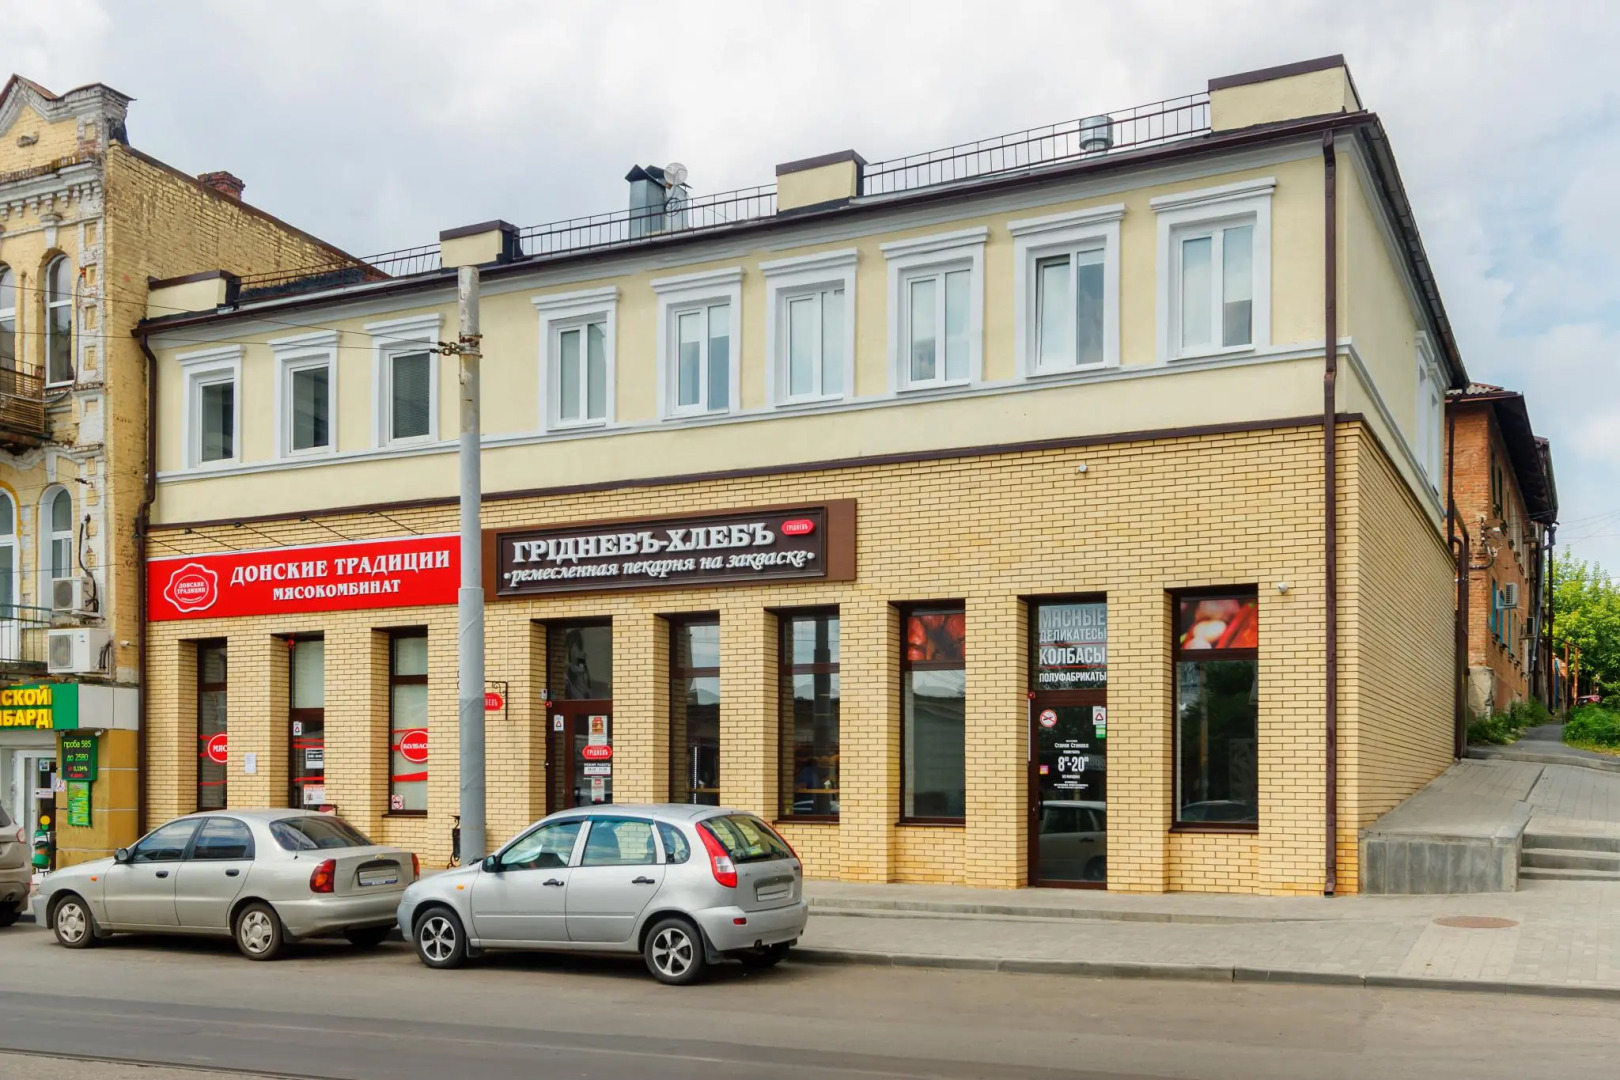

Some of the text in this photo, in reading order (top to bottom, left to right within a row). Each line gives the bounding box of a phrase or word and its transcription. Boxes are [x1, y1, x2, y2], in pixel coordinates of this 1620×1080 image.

[230, 550, 450, 587] ДОНСКИЕ ТРАДИЦИИ
[510, 550, 808, 587] ремесленная пекарня на закваске
[273, 579, 401, 601] МЯСОКОМБИНАТ
[1040, 608, 1105, 628] МЯСНЫЕ
[1040, 627, 1107, 643] ДЕЛИКАТЕСЫ
[1040, 647, 1106, 665] КОЛБАСЫ
[1039, 671, 1107, 682] ПОЛУФАБРИКАТЫ
[0, 708, 52, 728] БАРД
[63, 739, 92, 749] проба 585
